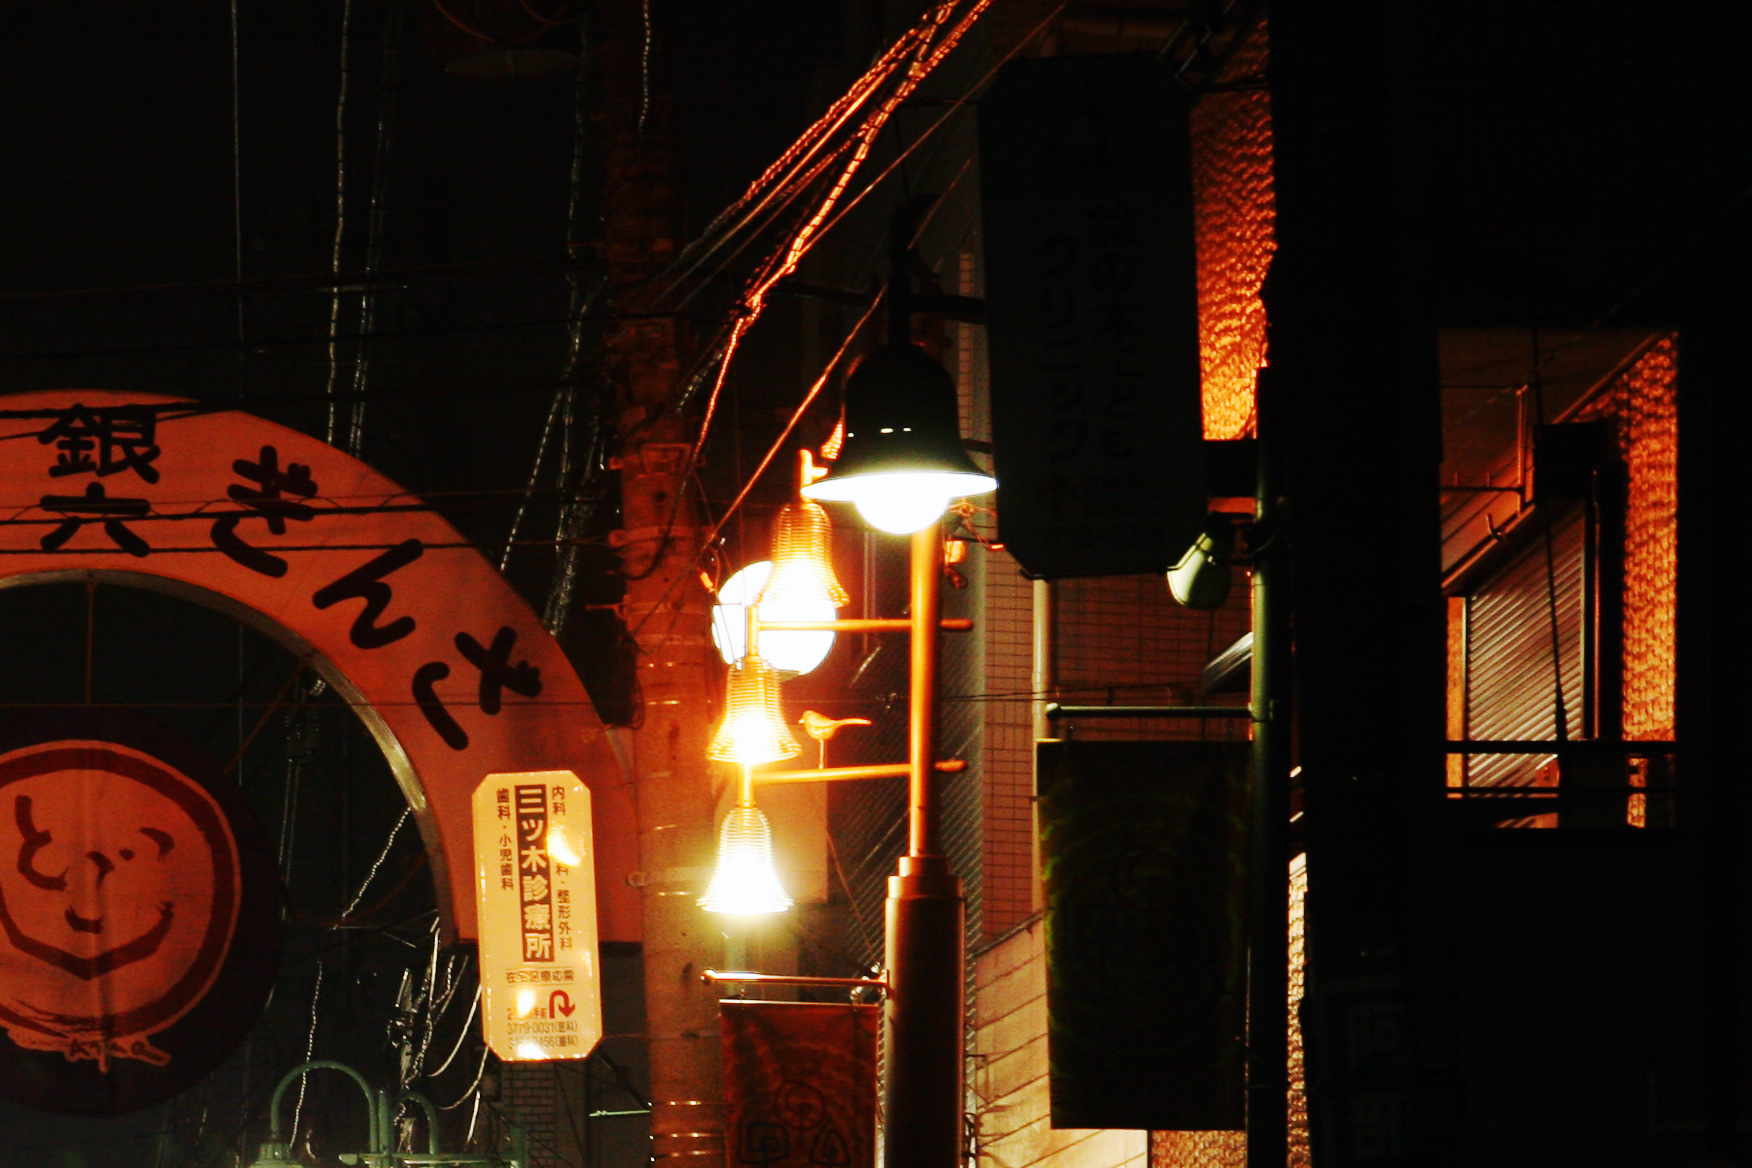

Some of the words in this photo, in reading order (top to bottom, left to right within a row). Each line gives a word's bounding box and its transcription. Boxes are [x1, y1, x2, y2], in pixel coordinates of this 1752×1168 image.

[212, 445, 542, 751] ぎんざ
[517, 787, 553, 960] 三ツ木診療所
